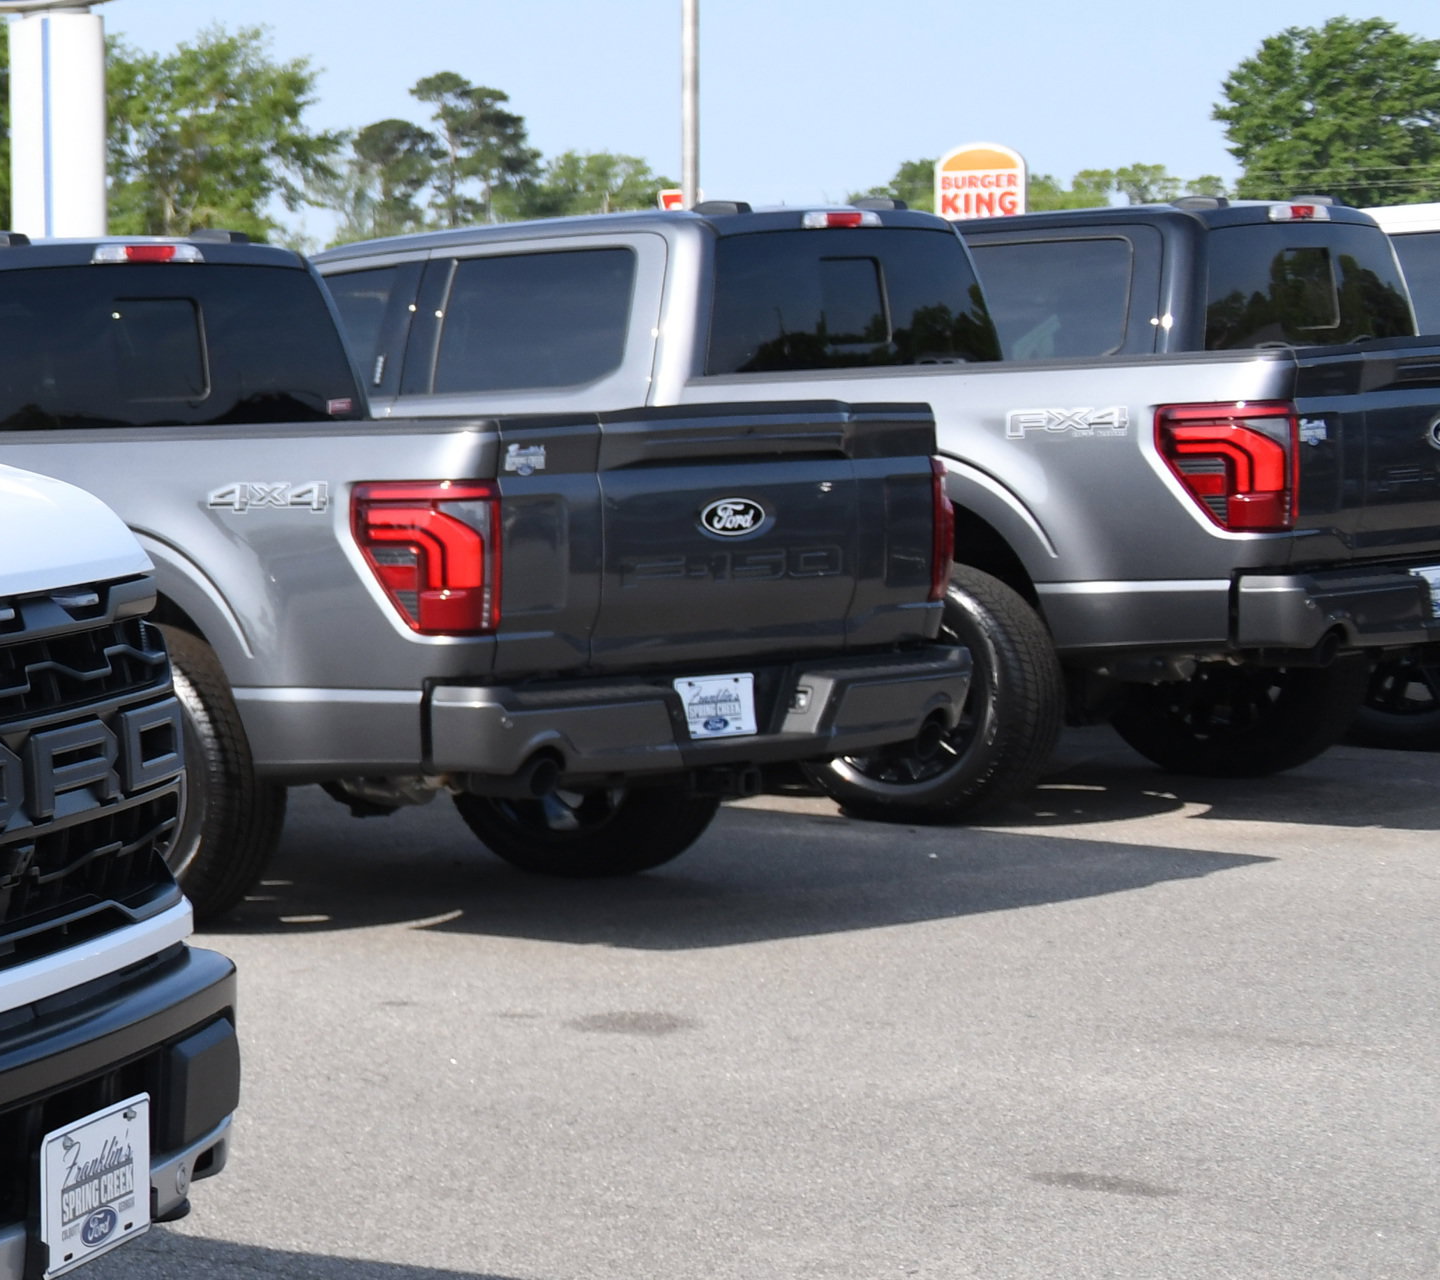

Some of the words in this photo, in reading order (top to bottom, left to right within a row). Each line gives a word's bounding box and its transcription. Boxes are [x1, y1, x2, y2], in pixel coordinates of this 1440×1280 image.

[941, 173, 1018, 190] BURGER
[941, 191, 1018, 216] KING
[1006, 407, 1128, 439] FX4
[712, 503, 756, 530] Ford
[63, 1128, 134, 1188] Franklin's
[62, 1178, 100, 1223] SPRING
[101, 1162, 134, 1204] CREEK
[87, 1212, 111, 1241] Ford
